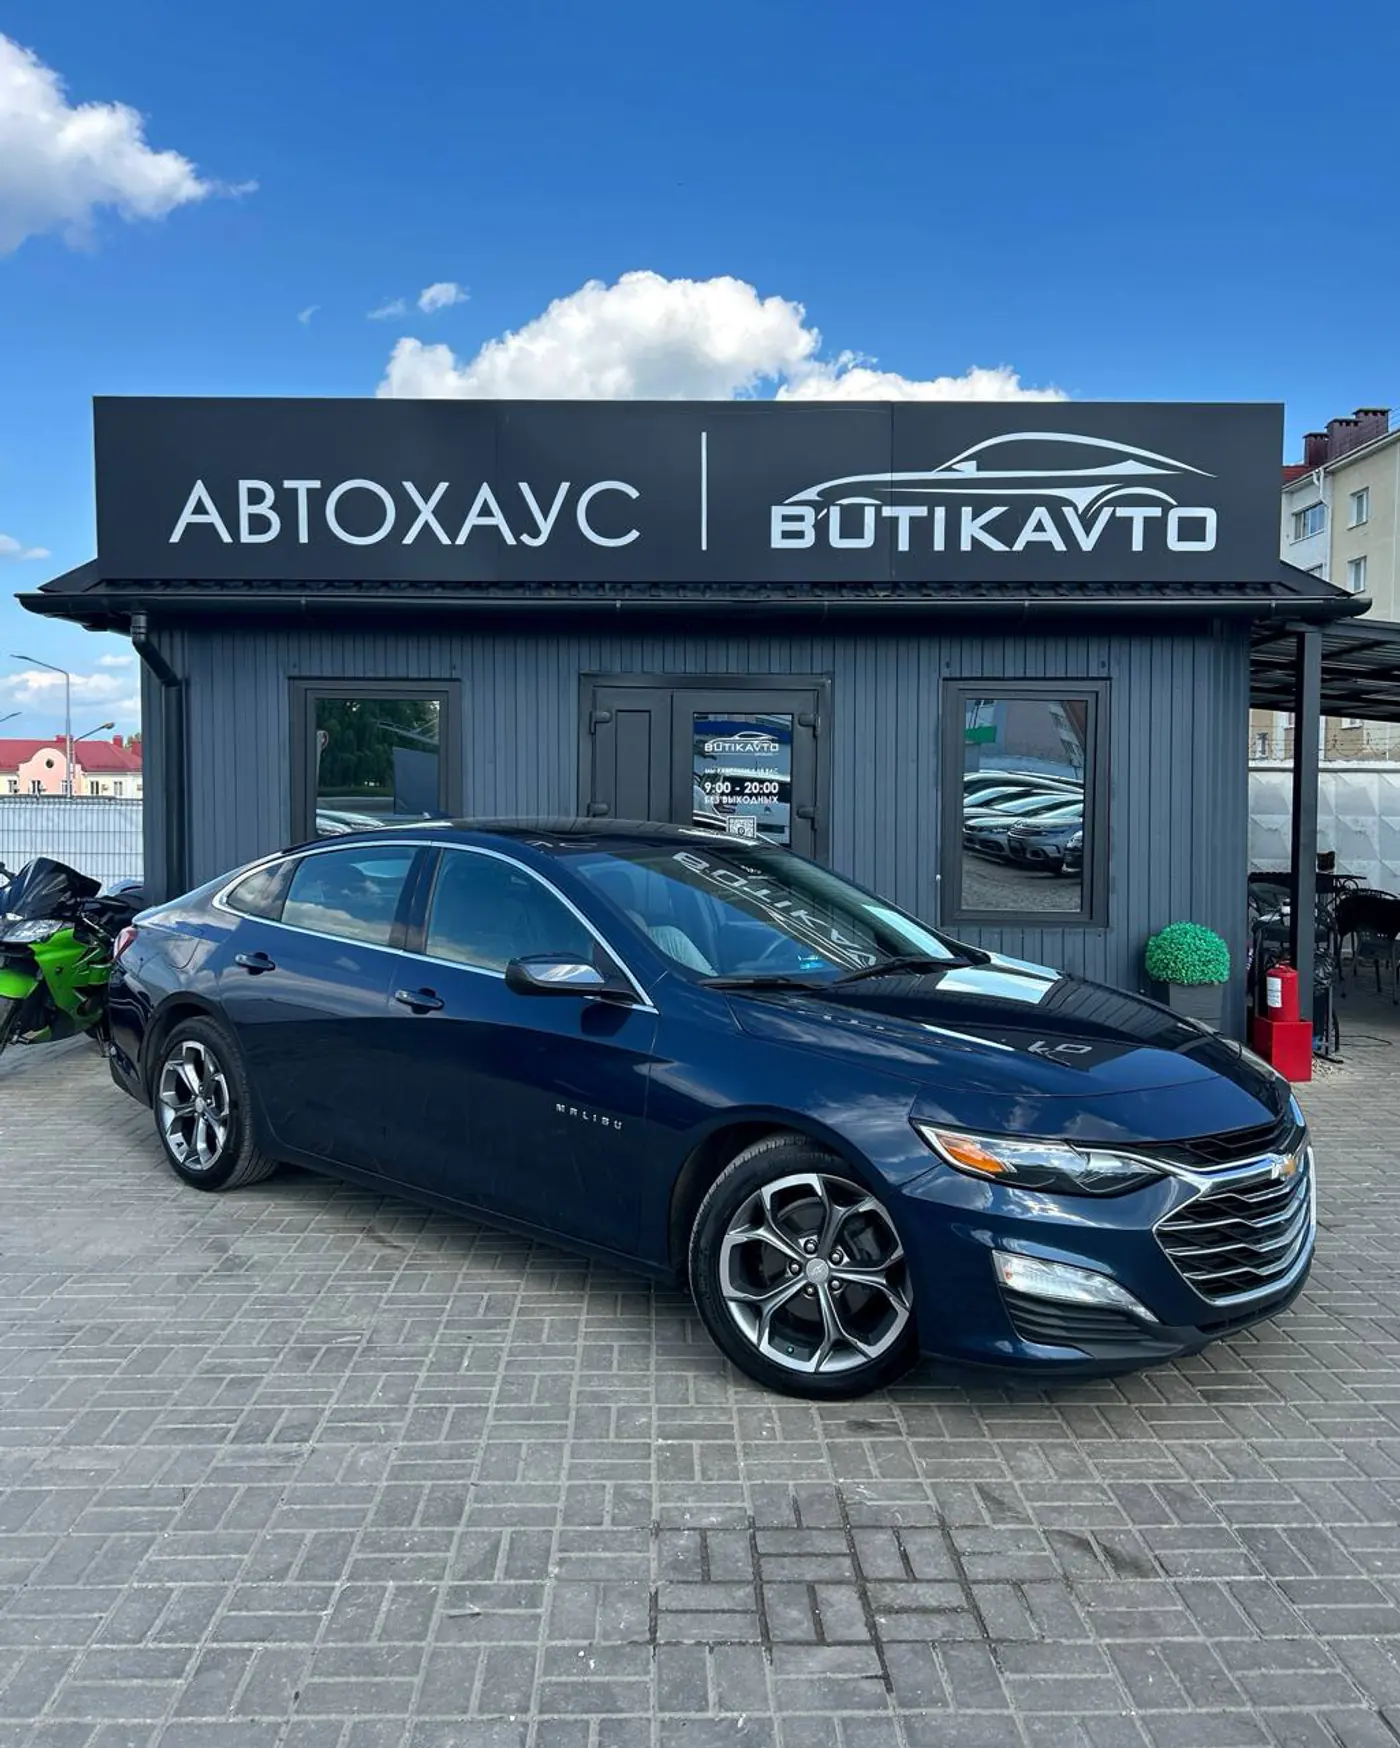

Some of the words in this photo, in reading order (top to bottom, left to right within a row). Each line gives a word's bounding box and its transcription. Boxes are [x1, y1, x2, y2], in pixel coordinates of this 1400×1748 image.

[169, 479, 640, 547] АВТОХАУС
[771, 505, 1217, 551] BUTIKAVTO
[704, 742, 779, 752] BUTIKAVTO
[704, 782, 731, 793] 9:00
[744, 782, 779, 793] 20:00
[722, 795, 779, 804] ВЫХОДНЫХ
[556, 1103, 622, 1130] MALIBU
